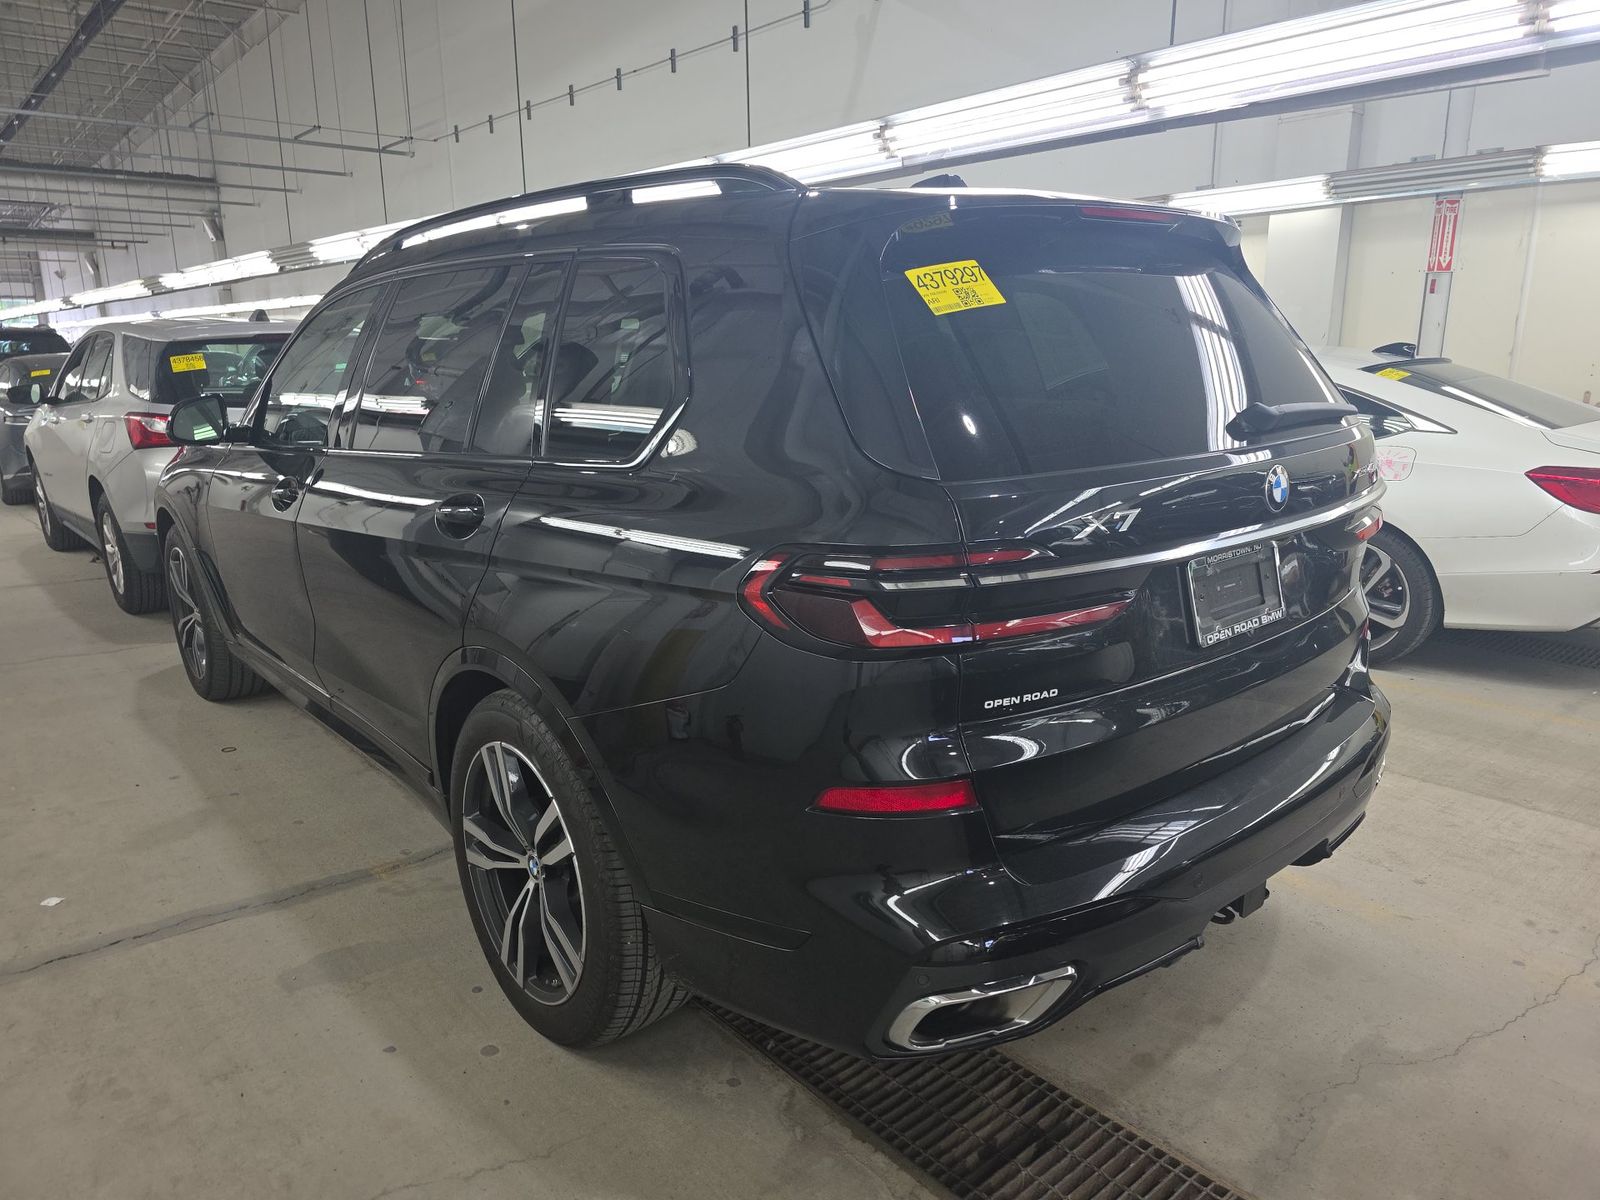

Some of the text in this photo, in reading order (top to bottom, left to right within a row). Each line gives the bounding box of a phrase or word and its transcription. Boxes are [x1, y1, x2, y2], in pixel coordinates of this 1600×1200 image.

[916, 265, 985, 291] 4379297
[1073, 508, 1141, 539] X7
[1253, 543, 1262, 551] NJ
[1206, 609, 1283, 644] OPEN ROAD BMW
[984, 688, 1058, 709] OPEN ROAD
